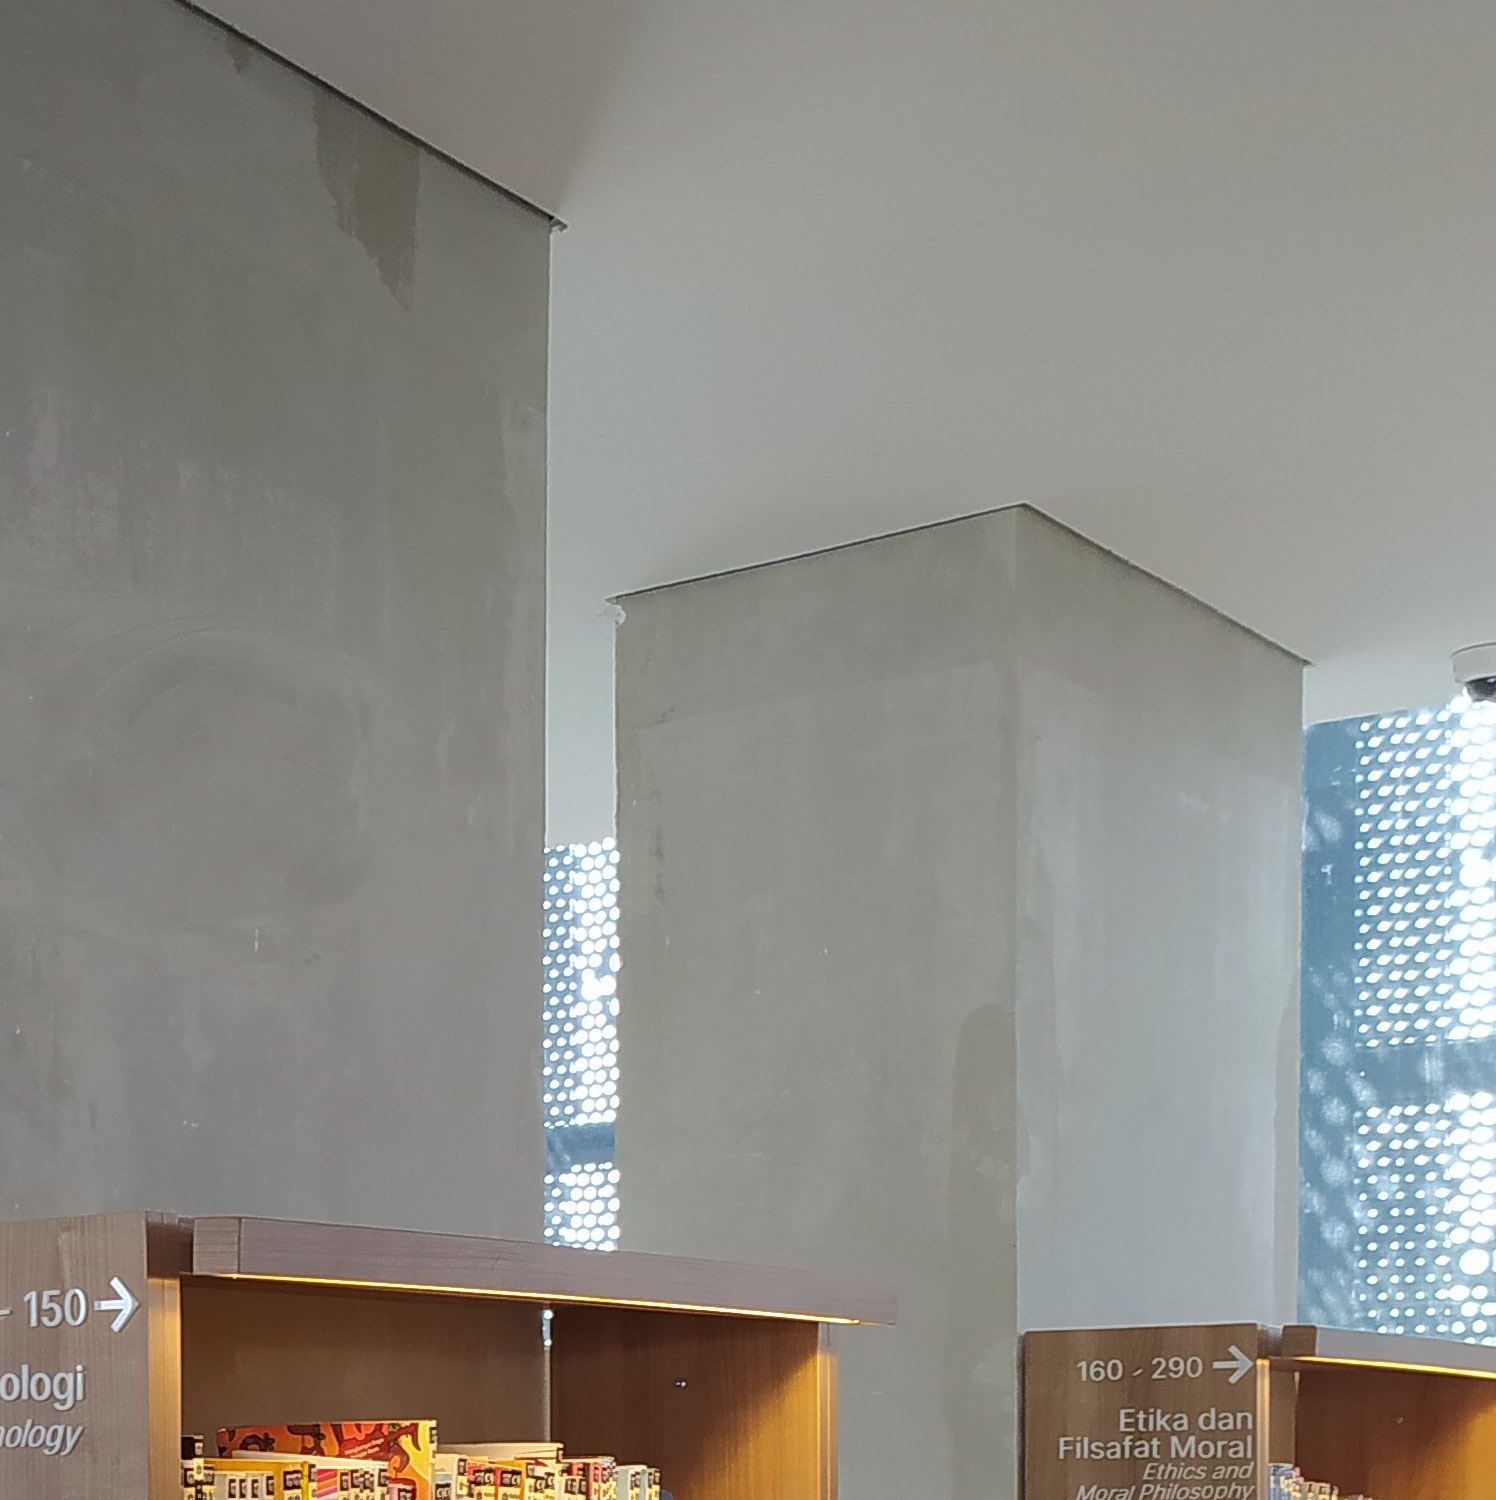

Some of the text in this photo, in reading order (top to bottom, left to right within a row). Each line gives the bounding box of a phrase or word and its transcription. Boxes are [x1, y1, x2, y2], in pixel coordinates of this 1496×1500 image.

[24, 1288, 87, 1328] 150
[1077, 1359, 1123, 1382] 160
[1151, 1356, 1203, 1379] 290
[1118, 1407, 1253, 1432] Etika dan
[1058, 1435, 1253, 1460] Filsafat Moral
[1142, 1461, 1254, 1480] Ethics and
